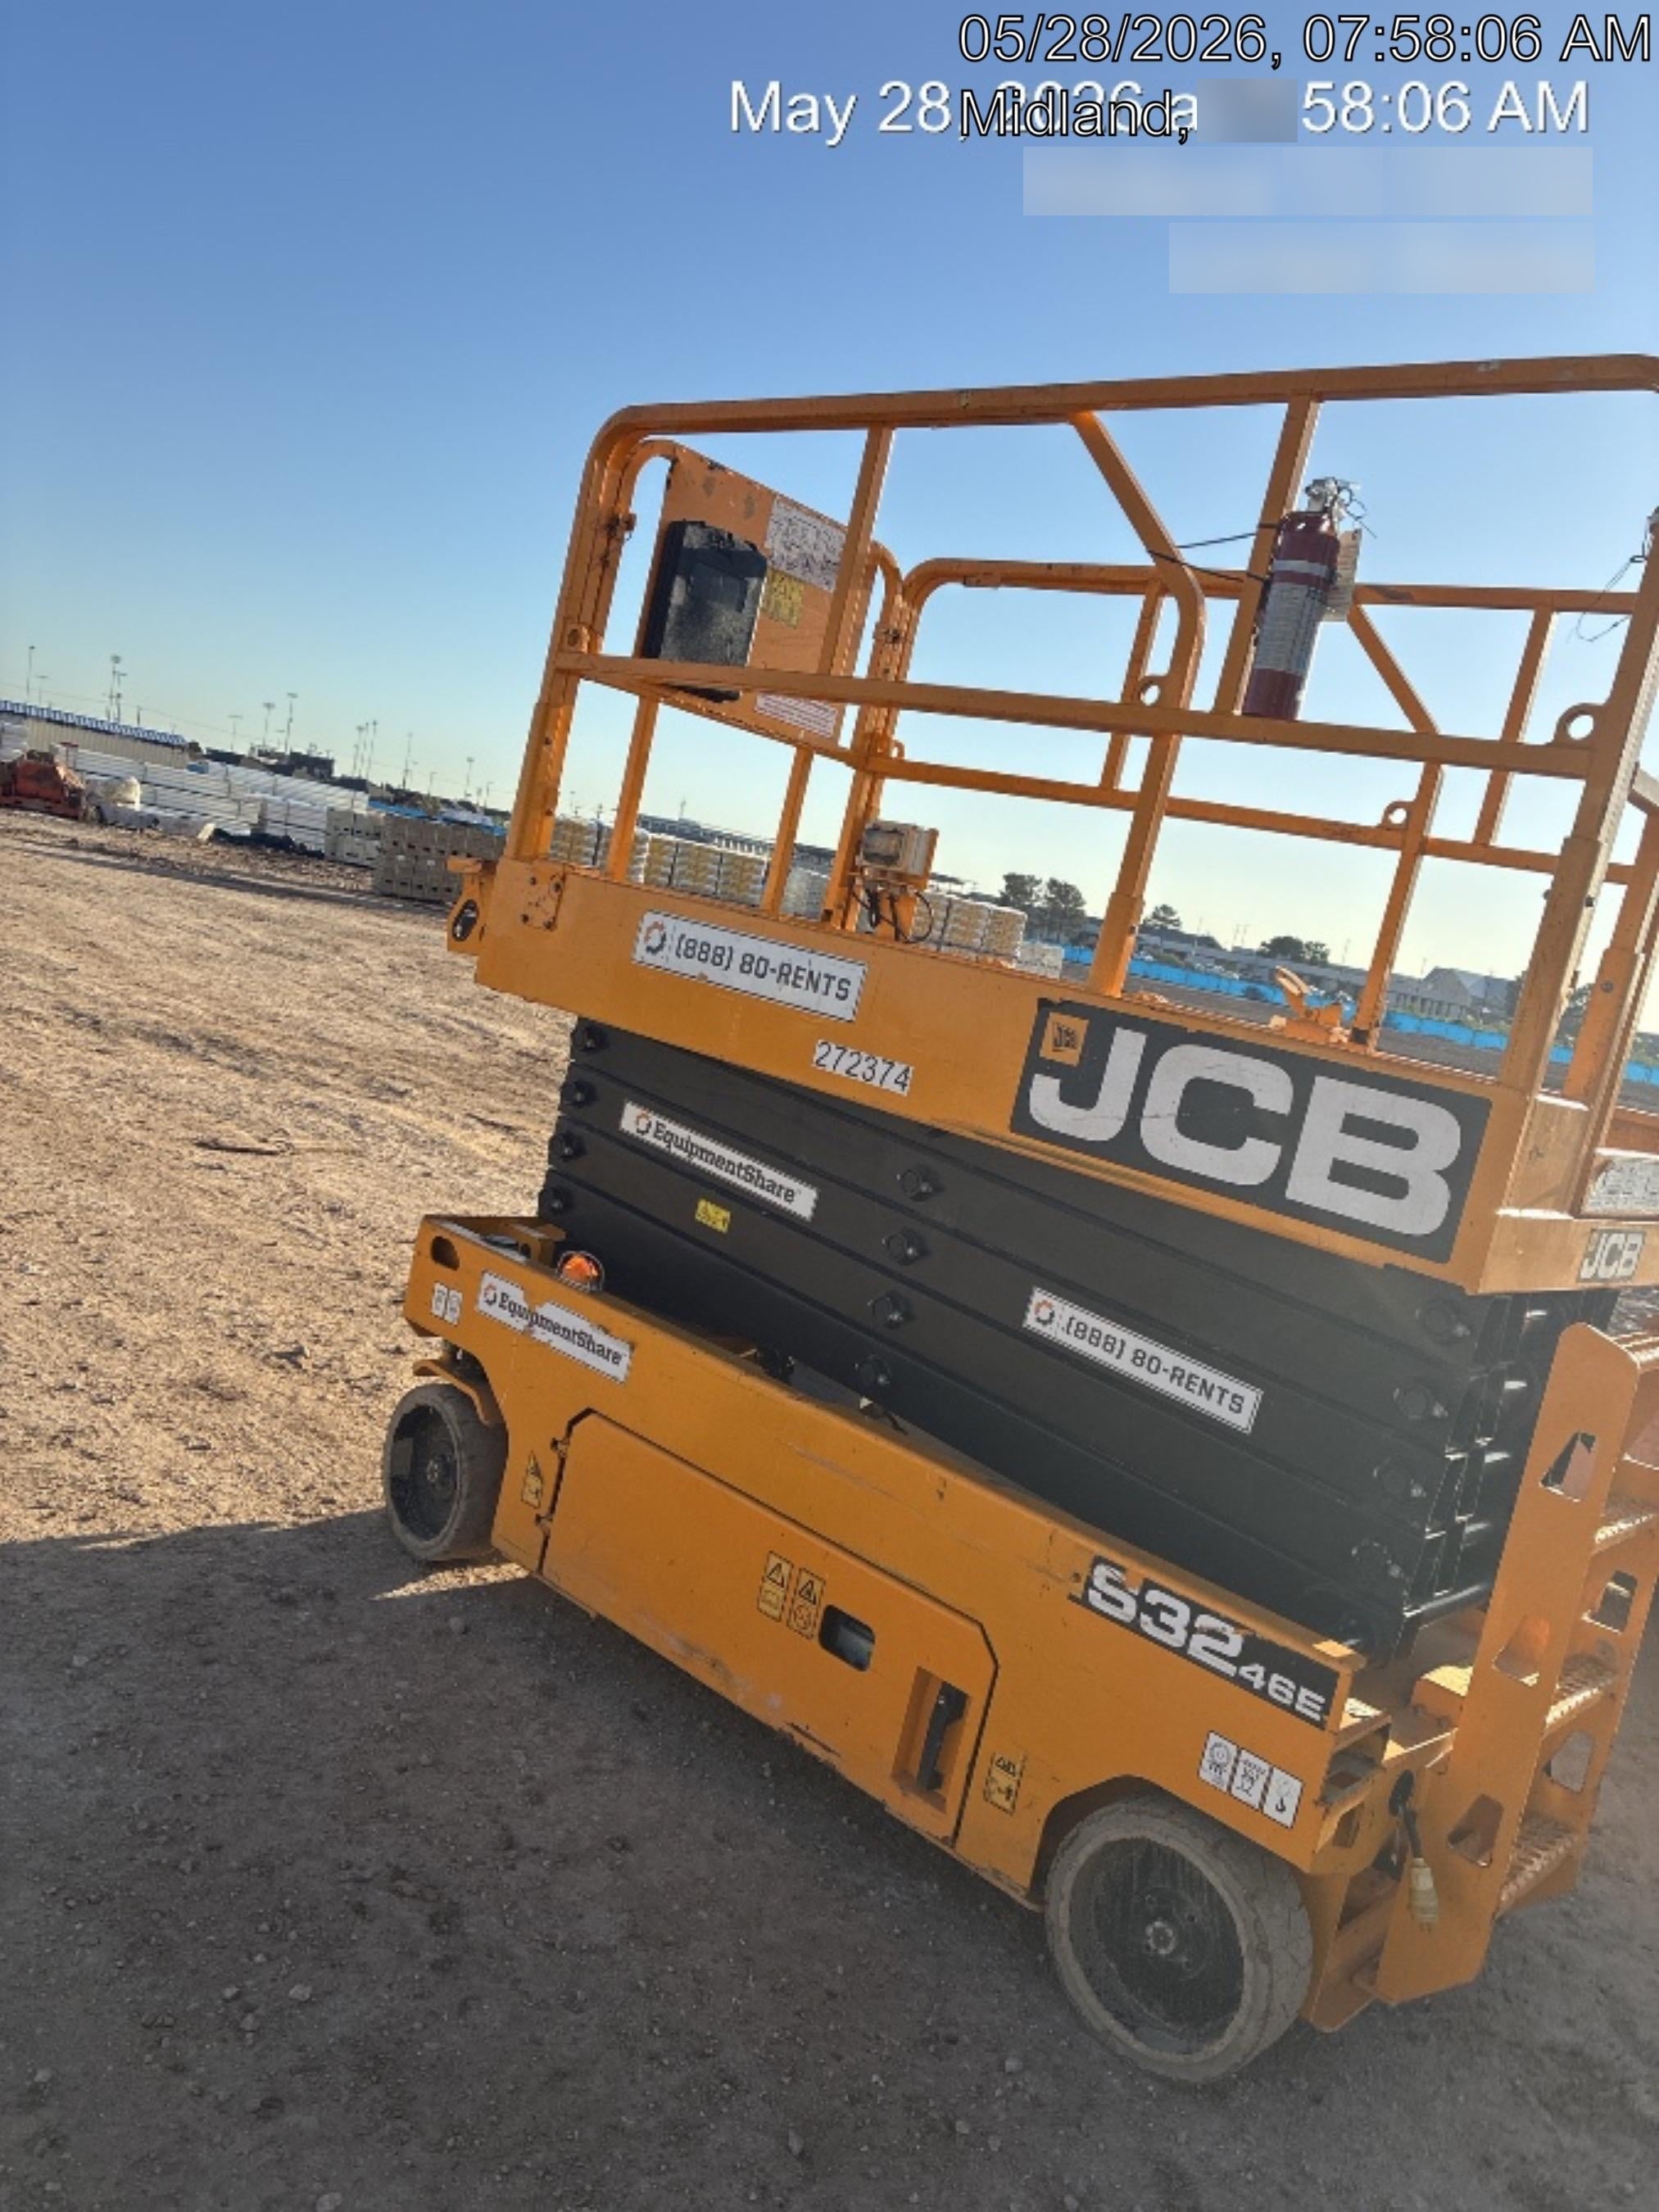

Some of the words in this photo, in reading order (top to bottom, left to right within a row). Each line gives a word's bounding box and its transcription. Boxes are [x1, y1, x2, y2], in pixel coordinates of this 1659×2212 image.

[675, 932, 734, 972] (888)
[739, 950, 851, 1003] 80-RENTS
[814, 1040, 910, 1092] 272374
[652, 1119, 797, 1204] EquipmentShare
[1028, 1027, 1462, 1237] JCB
[1580, 1232, 1644, 1280] JCB
[1065, 1315, 1126, 1360] (888)
[1131, 1348, 1245, 1415] 80-RENTS
